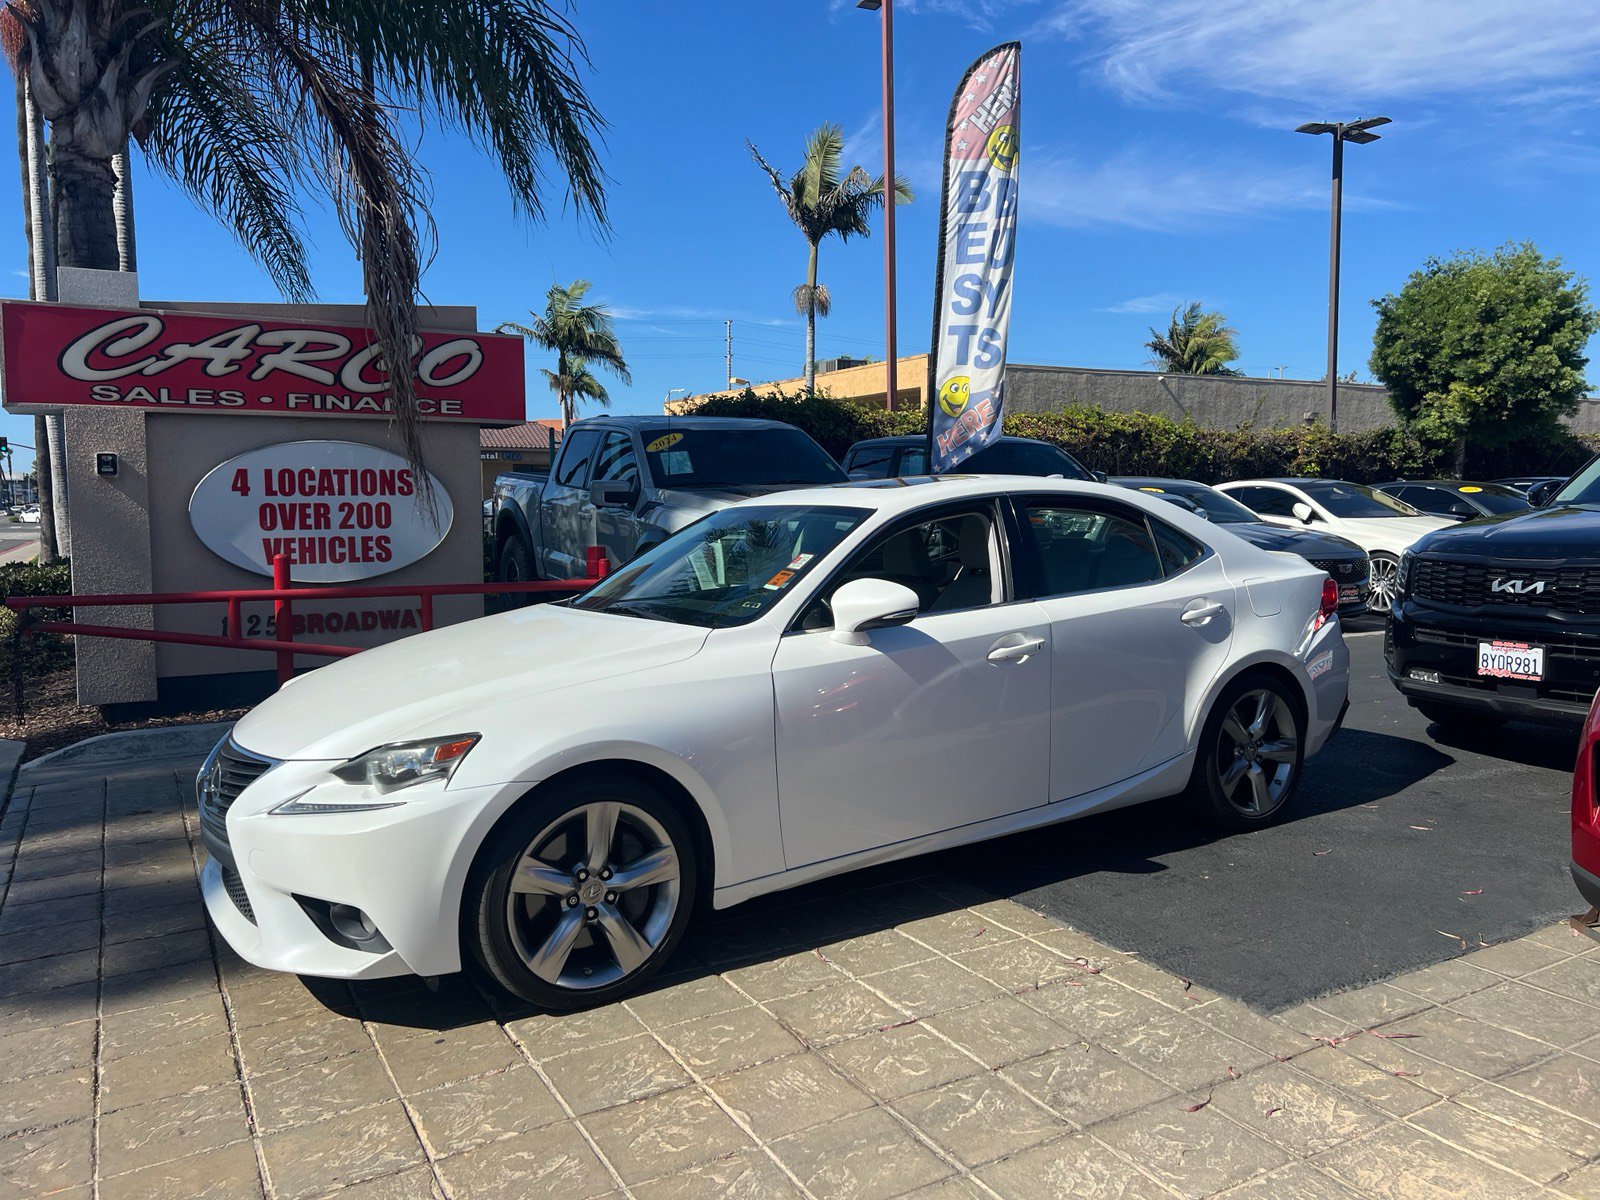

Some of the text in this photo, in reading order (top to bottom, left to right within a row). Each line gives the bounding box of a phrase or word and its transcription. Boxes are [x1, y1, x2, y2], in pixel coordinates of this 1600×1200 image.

[948, 171, 991, 365] BEST
[58, 315, 484, 394] CARCO
[91, 385, 245, 407] SALES
[936, 398, 997, 458] HERE
[231, 468, 414, 497] 4 LOCATIONS
[259, 502, 392, 531] OVER 200
[262, 535, 393, 565] VEHICLES
[1491, 578, 1545, 594] KIA
